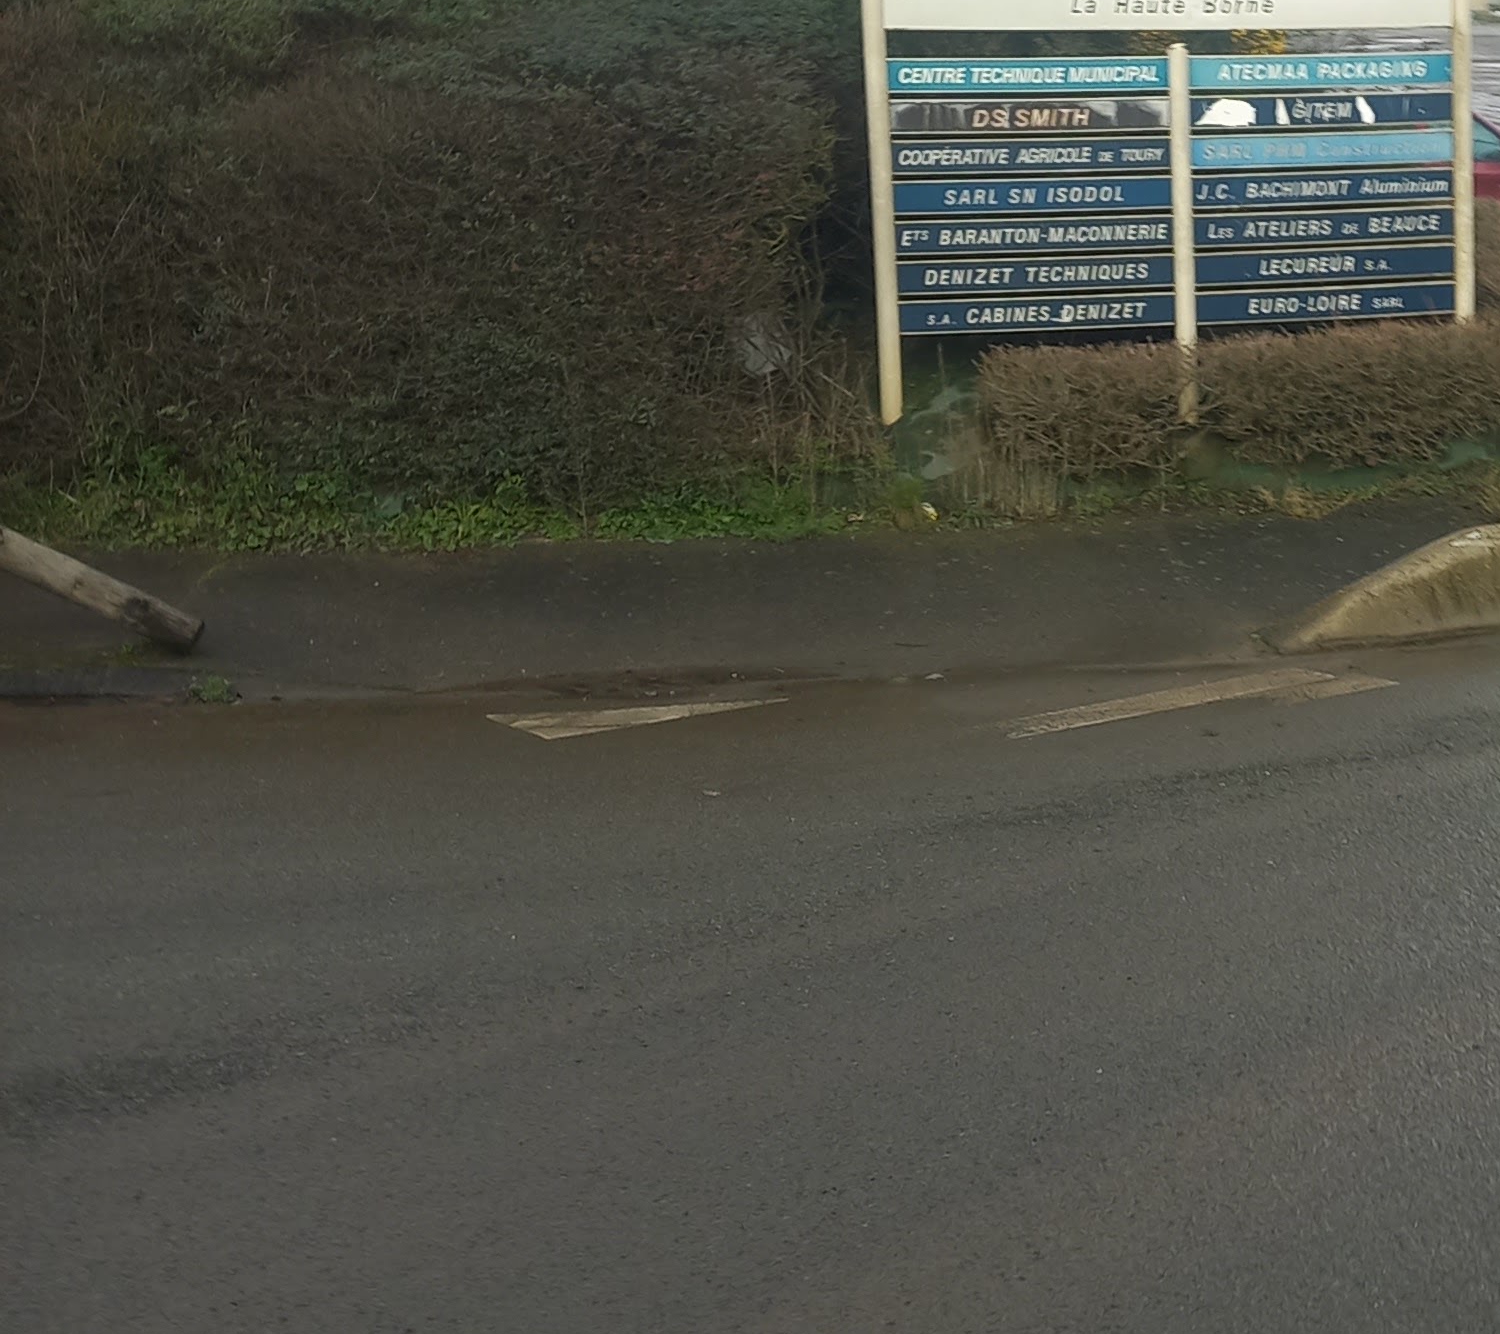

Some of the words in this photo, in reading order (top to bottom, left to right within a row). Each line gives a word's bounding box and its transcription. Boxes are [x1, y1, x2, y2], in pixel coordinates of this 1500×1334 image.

[898, 67, 966, 84] CENTRE
[970, 67, 1067, 83] TECHNIQUE
[1068, 66, 1159, 83] MUNICIPAL
[1316, 60, 1428, 79] PACKAGING
[972, 109, 1008, 128] DS
[1014, 108, 1090, 127] SMITH
[1015, 147, 1093, 163] AGRICOLE
[1098, 151, 1114, 162] DE
[1120, 148, 1165, 162] TOURY
[944, 188, 998, 205] SARL
[1007, 188, 1036, 204] SN
[1047, 186, 1125, 203] ISODOL
[1245, 180, 1352, 199] BACHIMONT
[1359, 178, 1449, 194] Aluminium
[1243, 220, 1332, 238] ATELIERS
[1368, 215, 1441, 233] BEAUCE
[924, 268, 1014, 285] DENIZET
[1025, 264, 1149, 283] TECHNIQUES
[966, 306, 1051, 324] CABINES
[1059, 302, 1147, 322] DENIZET
[1248, 294, 1362, 314] EURO-LOIRE
